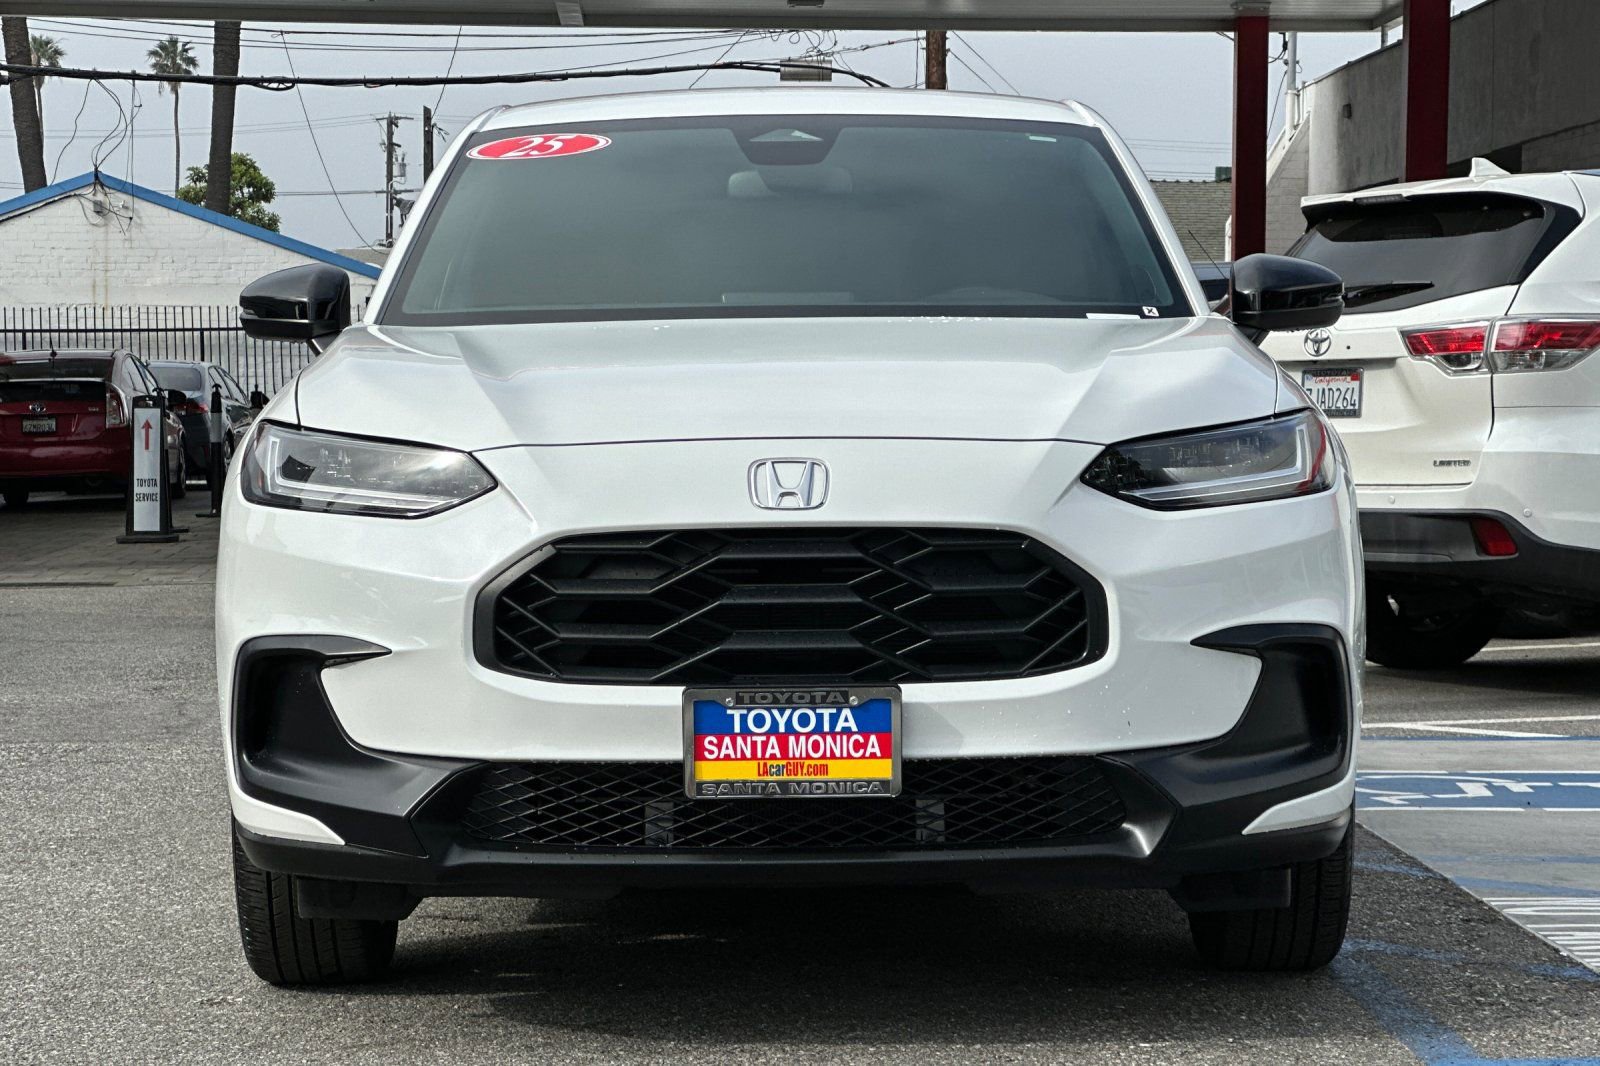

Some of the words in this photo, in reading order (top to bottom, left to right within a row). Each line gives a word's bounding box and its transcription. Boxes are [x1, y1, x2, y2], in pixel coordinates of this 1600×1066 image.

[499, 134, 578, 157] 25
[136, 478, 158, 487] TOYOTA
[135, 493, 158, 502] SERVICE
[739, 692, 845, 704] TOYOTA
[726, 707, 858, 733] TOYOTA
[703, 735, 781, 759] SANTA
[788, 734, 881, 758] MONICA
[757, 761, 829, 777] LAcarGUY.com
[702, 782, 781, 795] SANTA
[788, 781, 885, 794] MONICA
